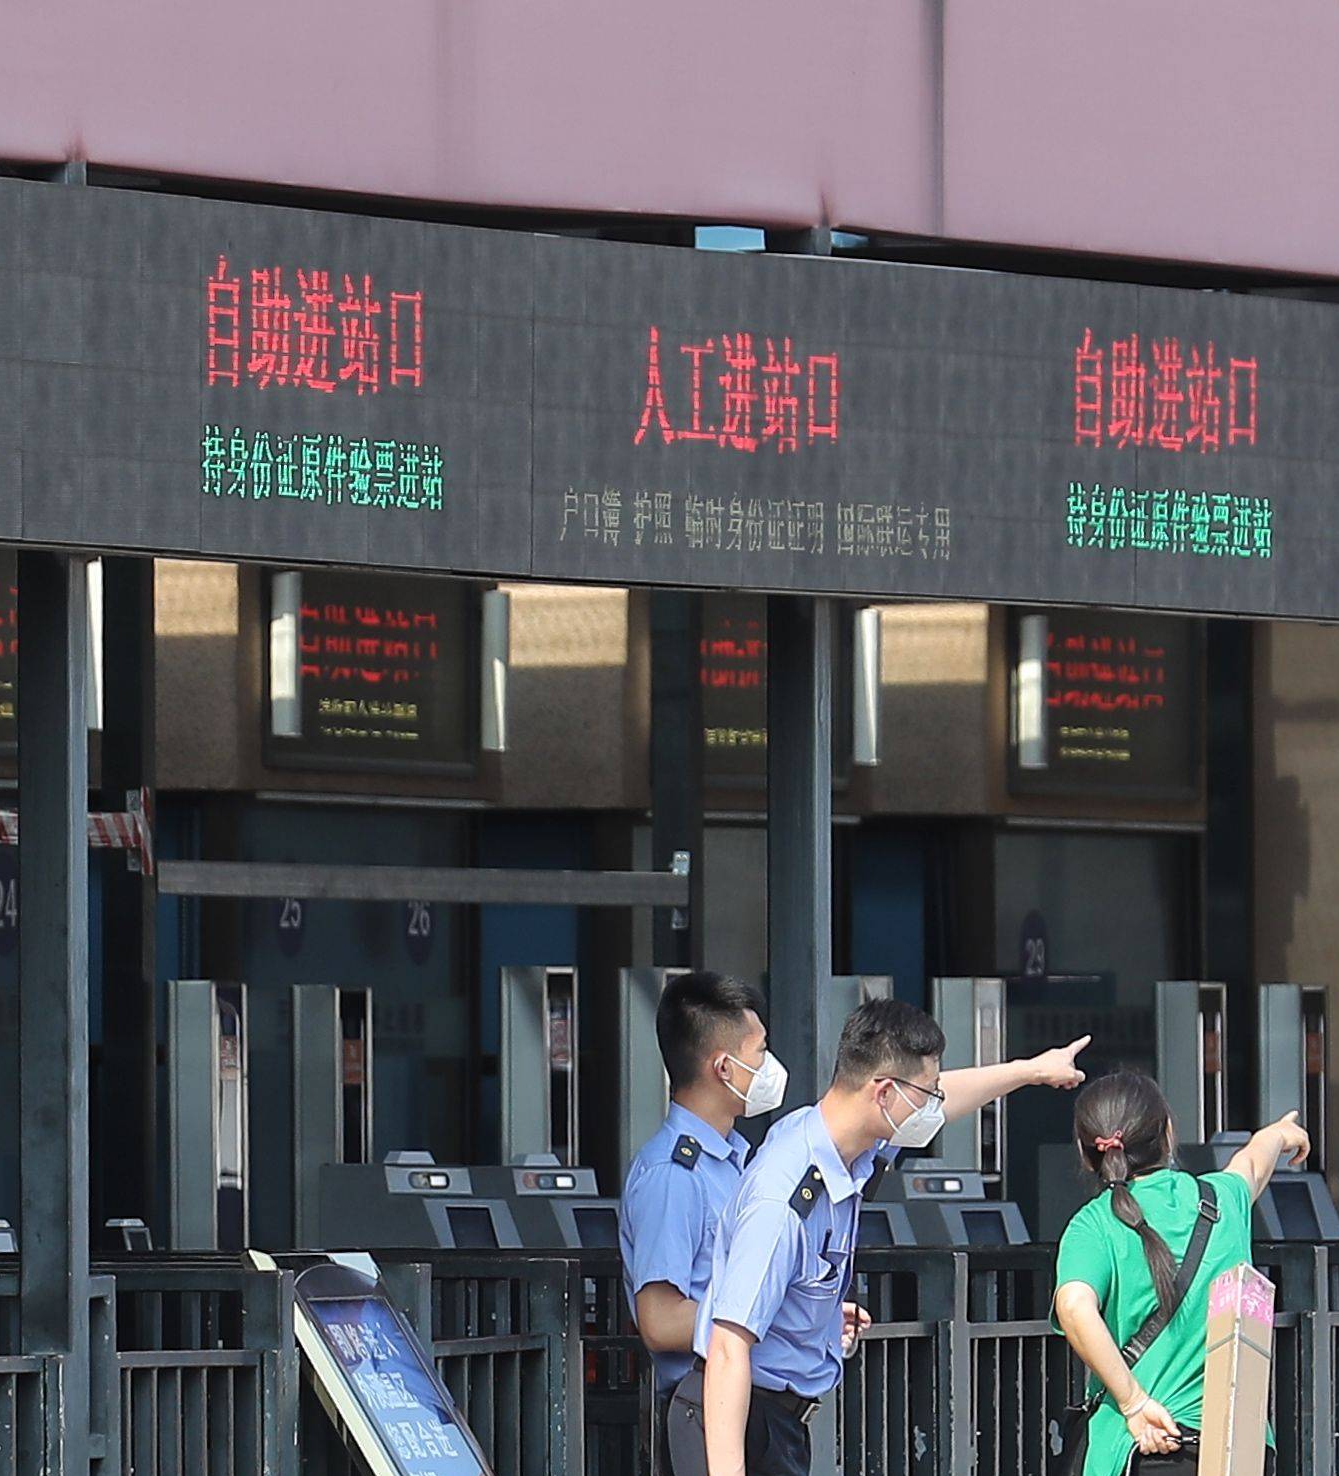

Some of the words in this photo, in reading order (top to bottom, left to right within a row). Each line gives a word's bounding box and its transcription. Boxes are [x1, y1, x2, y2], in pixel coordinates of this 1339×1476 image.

[206, 254, 424, 396] 自助进站口
[633, 325, 842, 455] 人工进站口
[1073, 327, 1260, 454] 自助进站口
[201, 426, 446, 511] 持身份证原件验票进站
[1065, 482, 1274, 560] 持身份证原件验票进站
